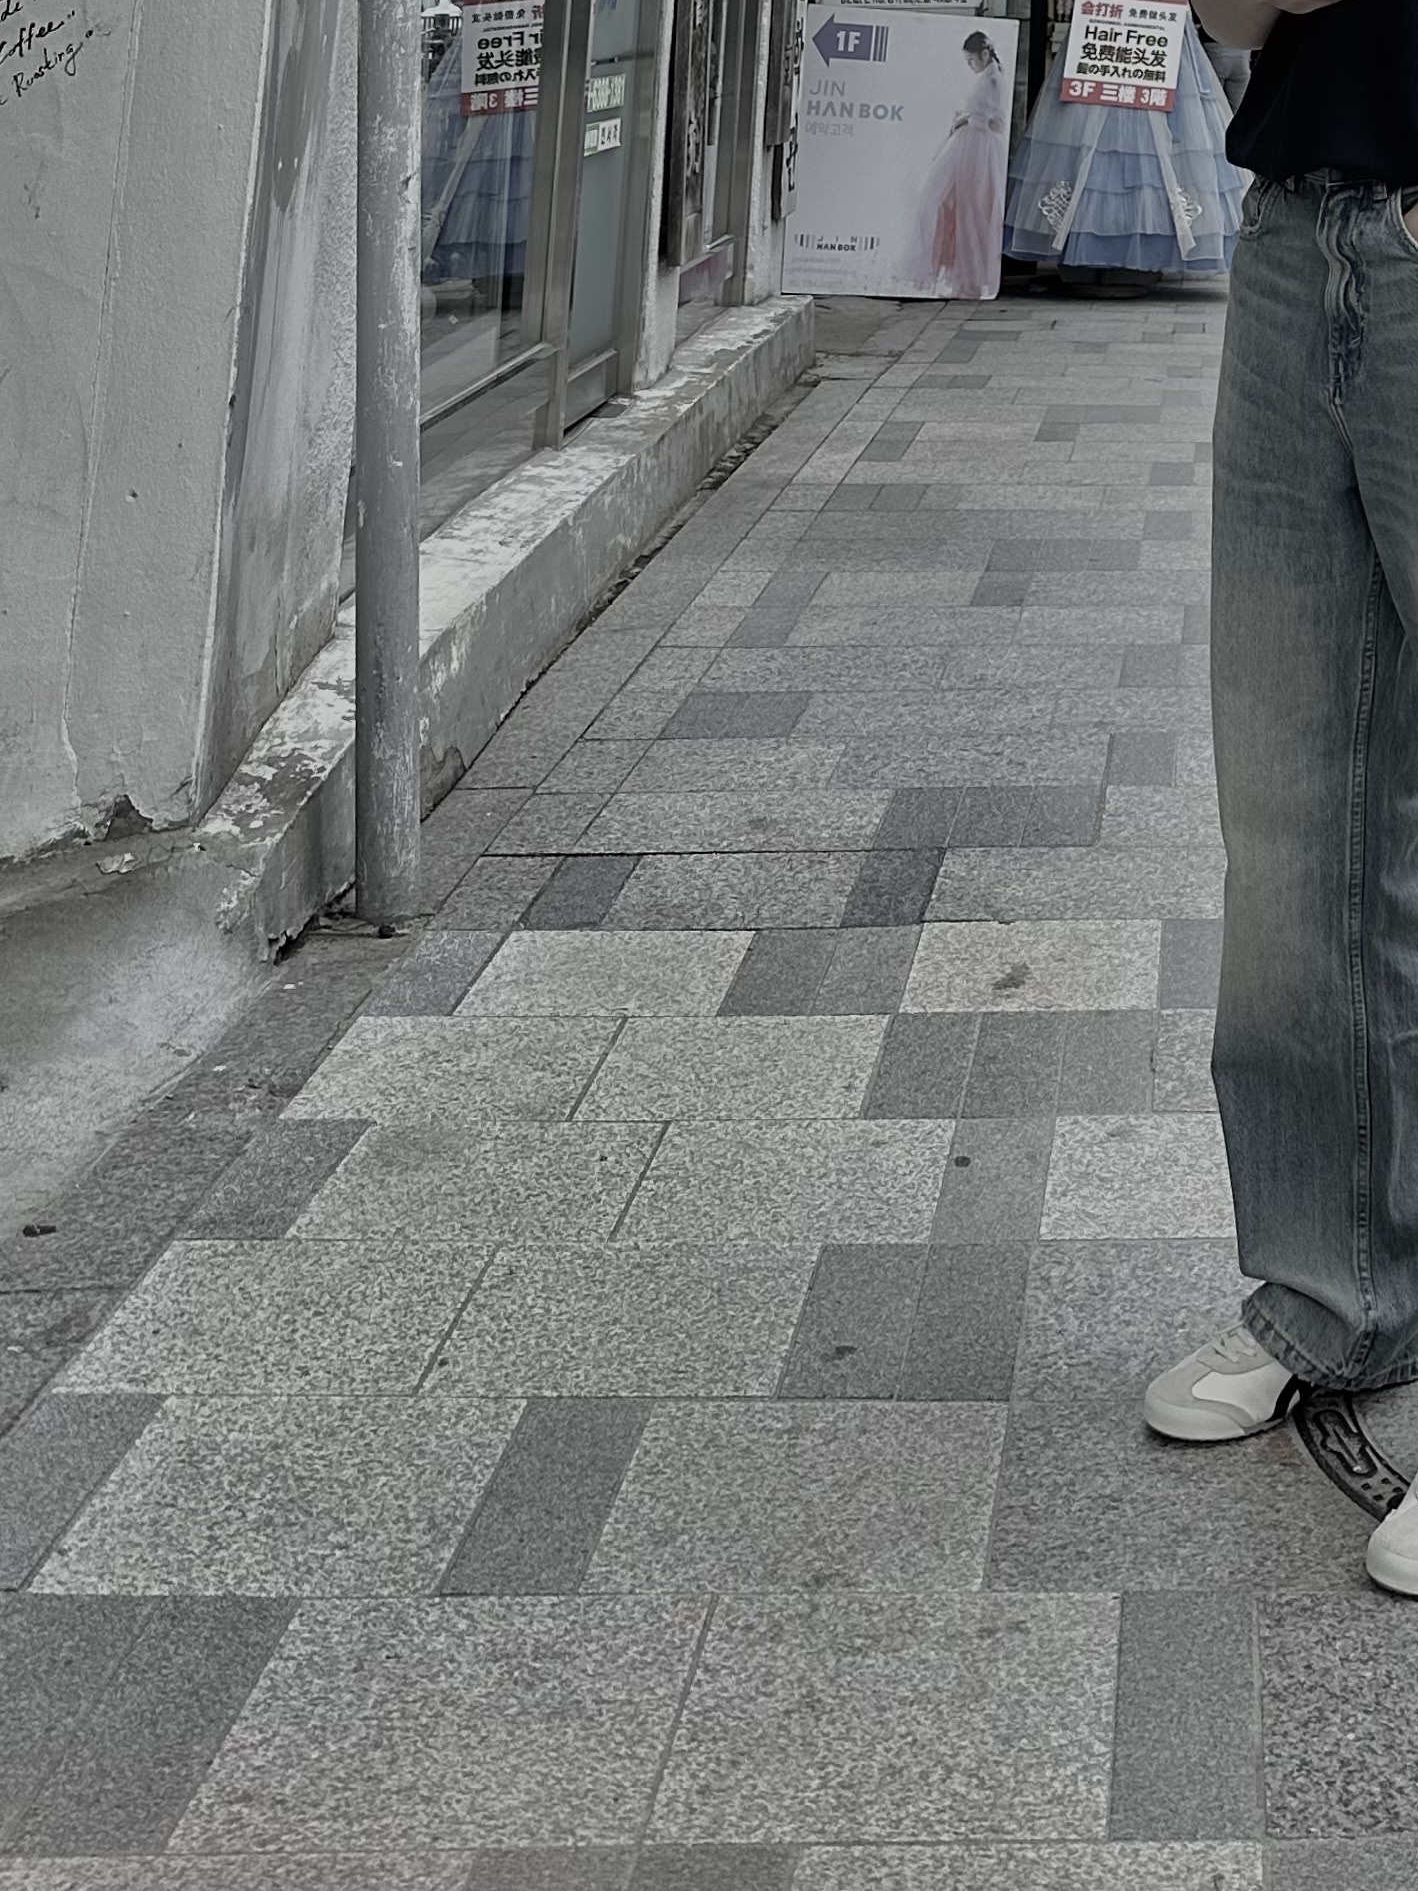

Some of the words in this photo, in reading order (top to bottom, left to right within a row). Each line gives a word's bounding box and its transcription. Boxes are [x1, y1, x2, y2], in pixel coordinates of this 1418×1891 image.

[837, 31, 861, 52] 1F
[1085, 25, 1122, 43] Hair
[1126, 30, 1168, 48] Free
[809, 80, 846, 97] JIN
[1069, 80, 1096, 97] 3F
[1100, 84, 1136, 104] 三楼
[1141, 89, 1167, 106] 3階
